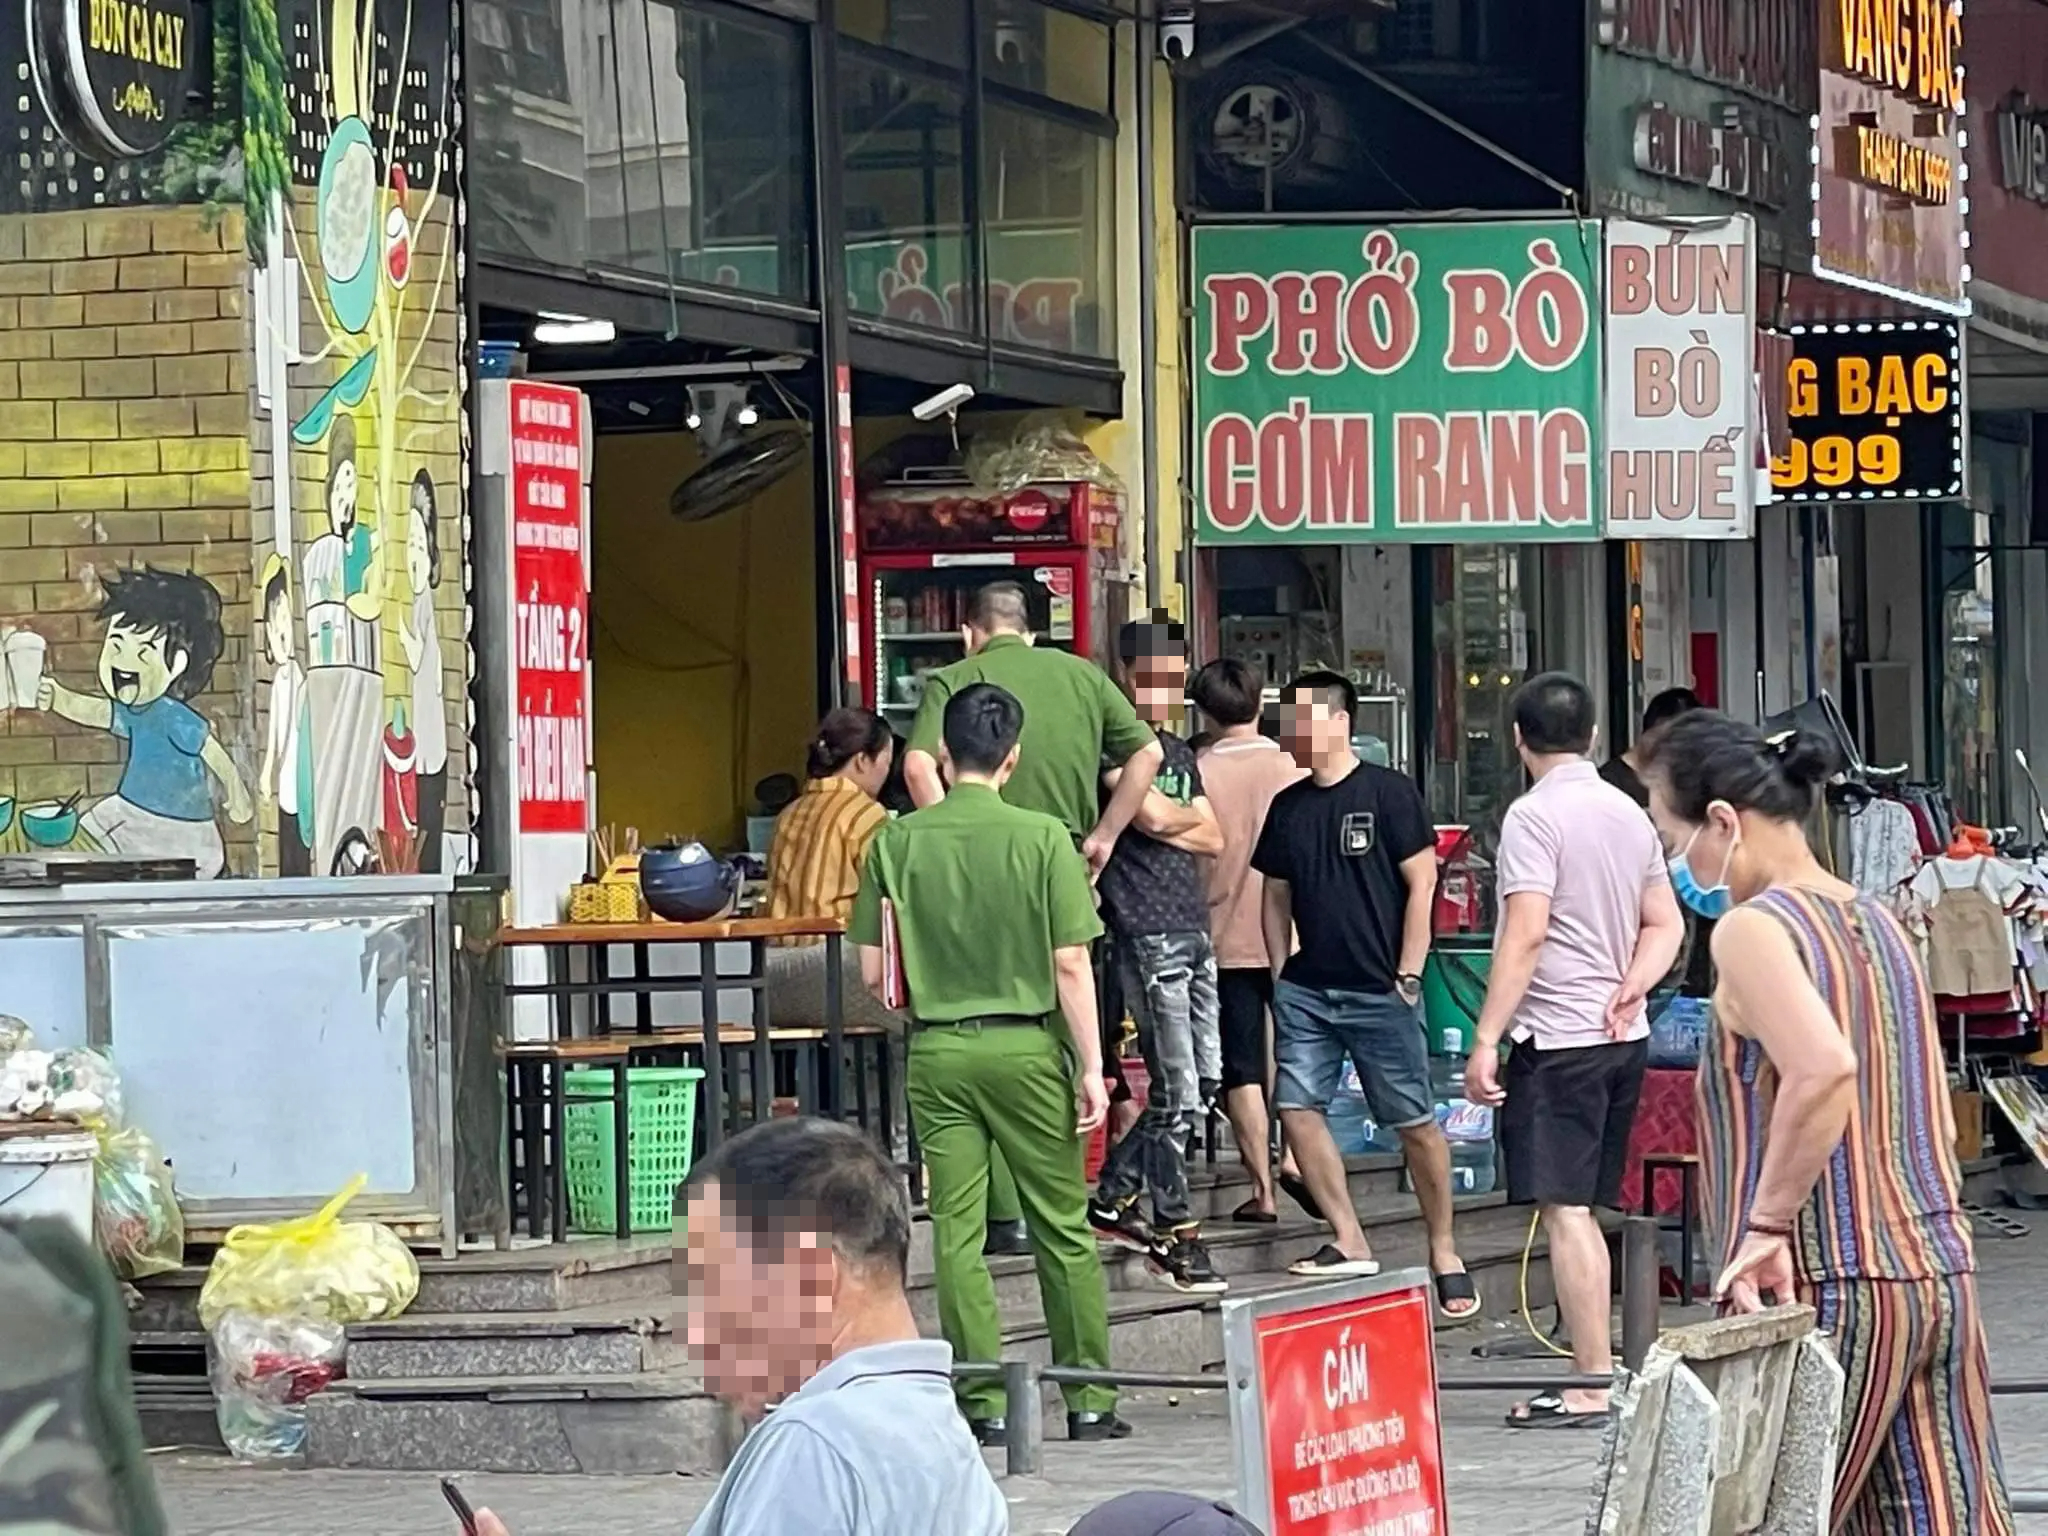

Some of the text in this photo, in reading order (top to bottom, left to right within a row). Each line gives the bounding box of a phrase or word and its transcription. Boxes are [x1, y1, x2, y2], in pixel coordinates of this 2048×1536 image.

[154, 10, 184, 69] CAY
[1204, 230, 1589, 375] PHỞ BÒ
[1610, 230, 1746, 315] BÚN
[1634, 329, 1721, 418] BÒ
[1837, 353, 1948, 427] BẠC
[1204, 397, 1592, 531] CƠM RANG
[1610, 427, 1744, 521] HUẾ
[568, 606, 582, 672] 2
